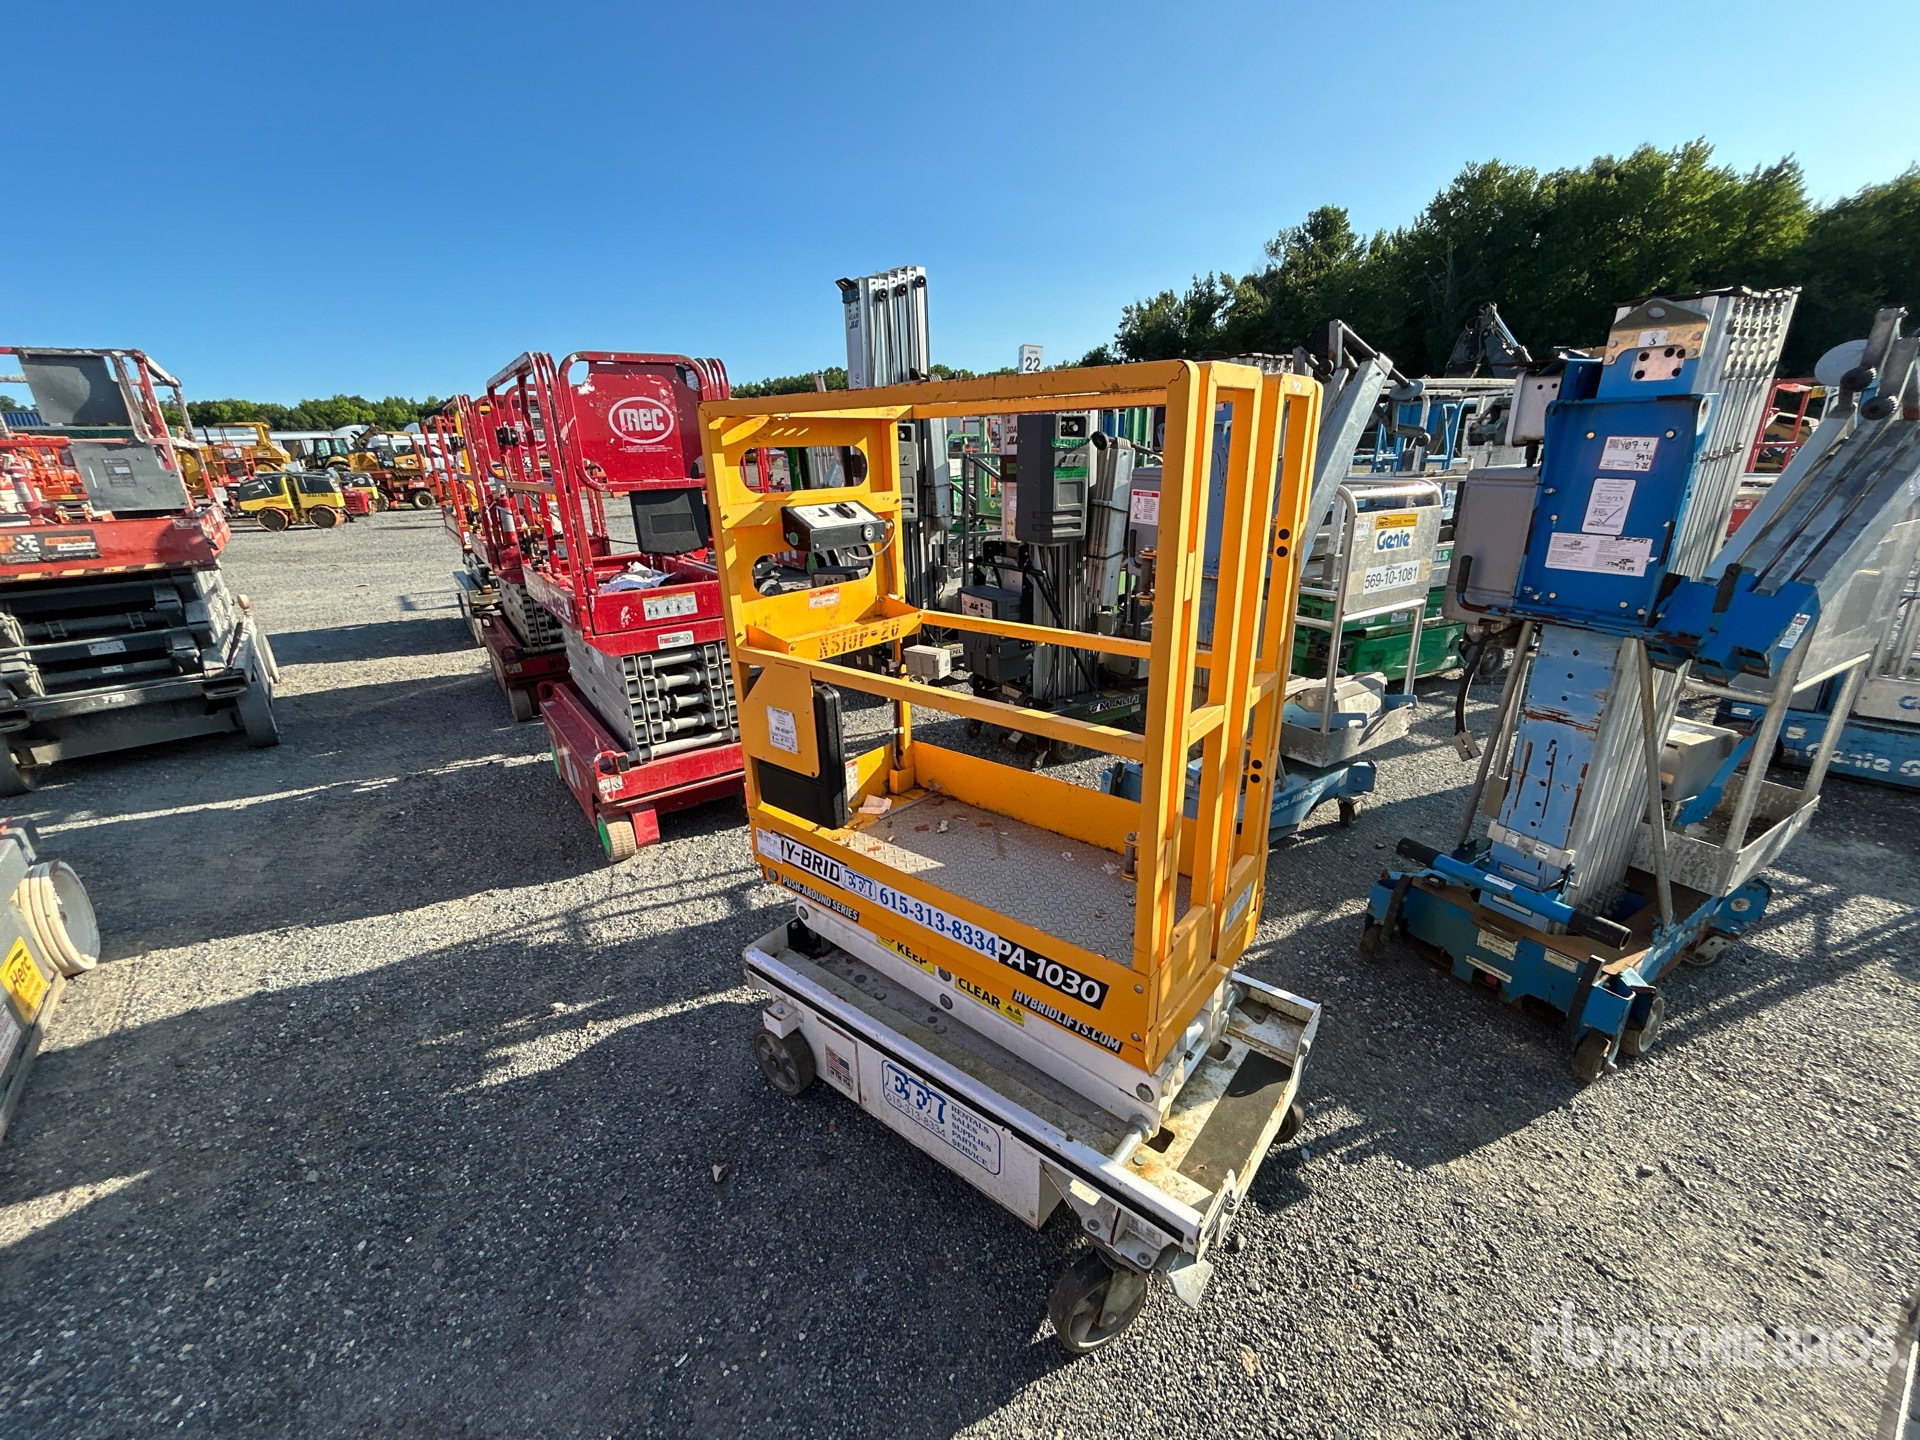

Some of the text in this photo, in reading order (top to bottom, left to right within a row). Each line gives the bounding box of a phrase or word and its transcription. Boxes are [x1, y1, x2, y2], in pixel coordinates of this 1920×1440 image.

[1025, 356, 1040, 372] 22
[1377, 529, 1411, 550] Genie
[1364, 566, 1418, 589] 569-10-1081
[782, 876, 858, 921] PUSH-AROUND SERIES
[879, 887, 997, 957] 615-313-8334
[9, 955, 32, 989] Herc
[998, 943, 1101, 1004] PA-1030
[958, 977, 1001, 1010] CLEAR
[1013, 989, 1121, 1052] HYBRIDLIFTS.COM
[885, 1063, 947, 1125] EFI
[886, 1091, 946, 1138] 615-313-8334
[951, 1104, 990, 1134] RENTALS
[951, 1113, 979, 1135] SALES
[951, 1121, 992, 1153] SUPPLIES
[951, 1129, 979, 1152] PARTS
[951, 1138, 988, 1168] SERVICE
